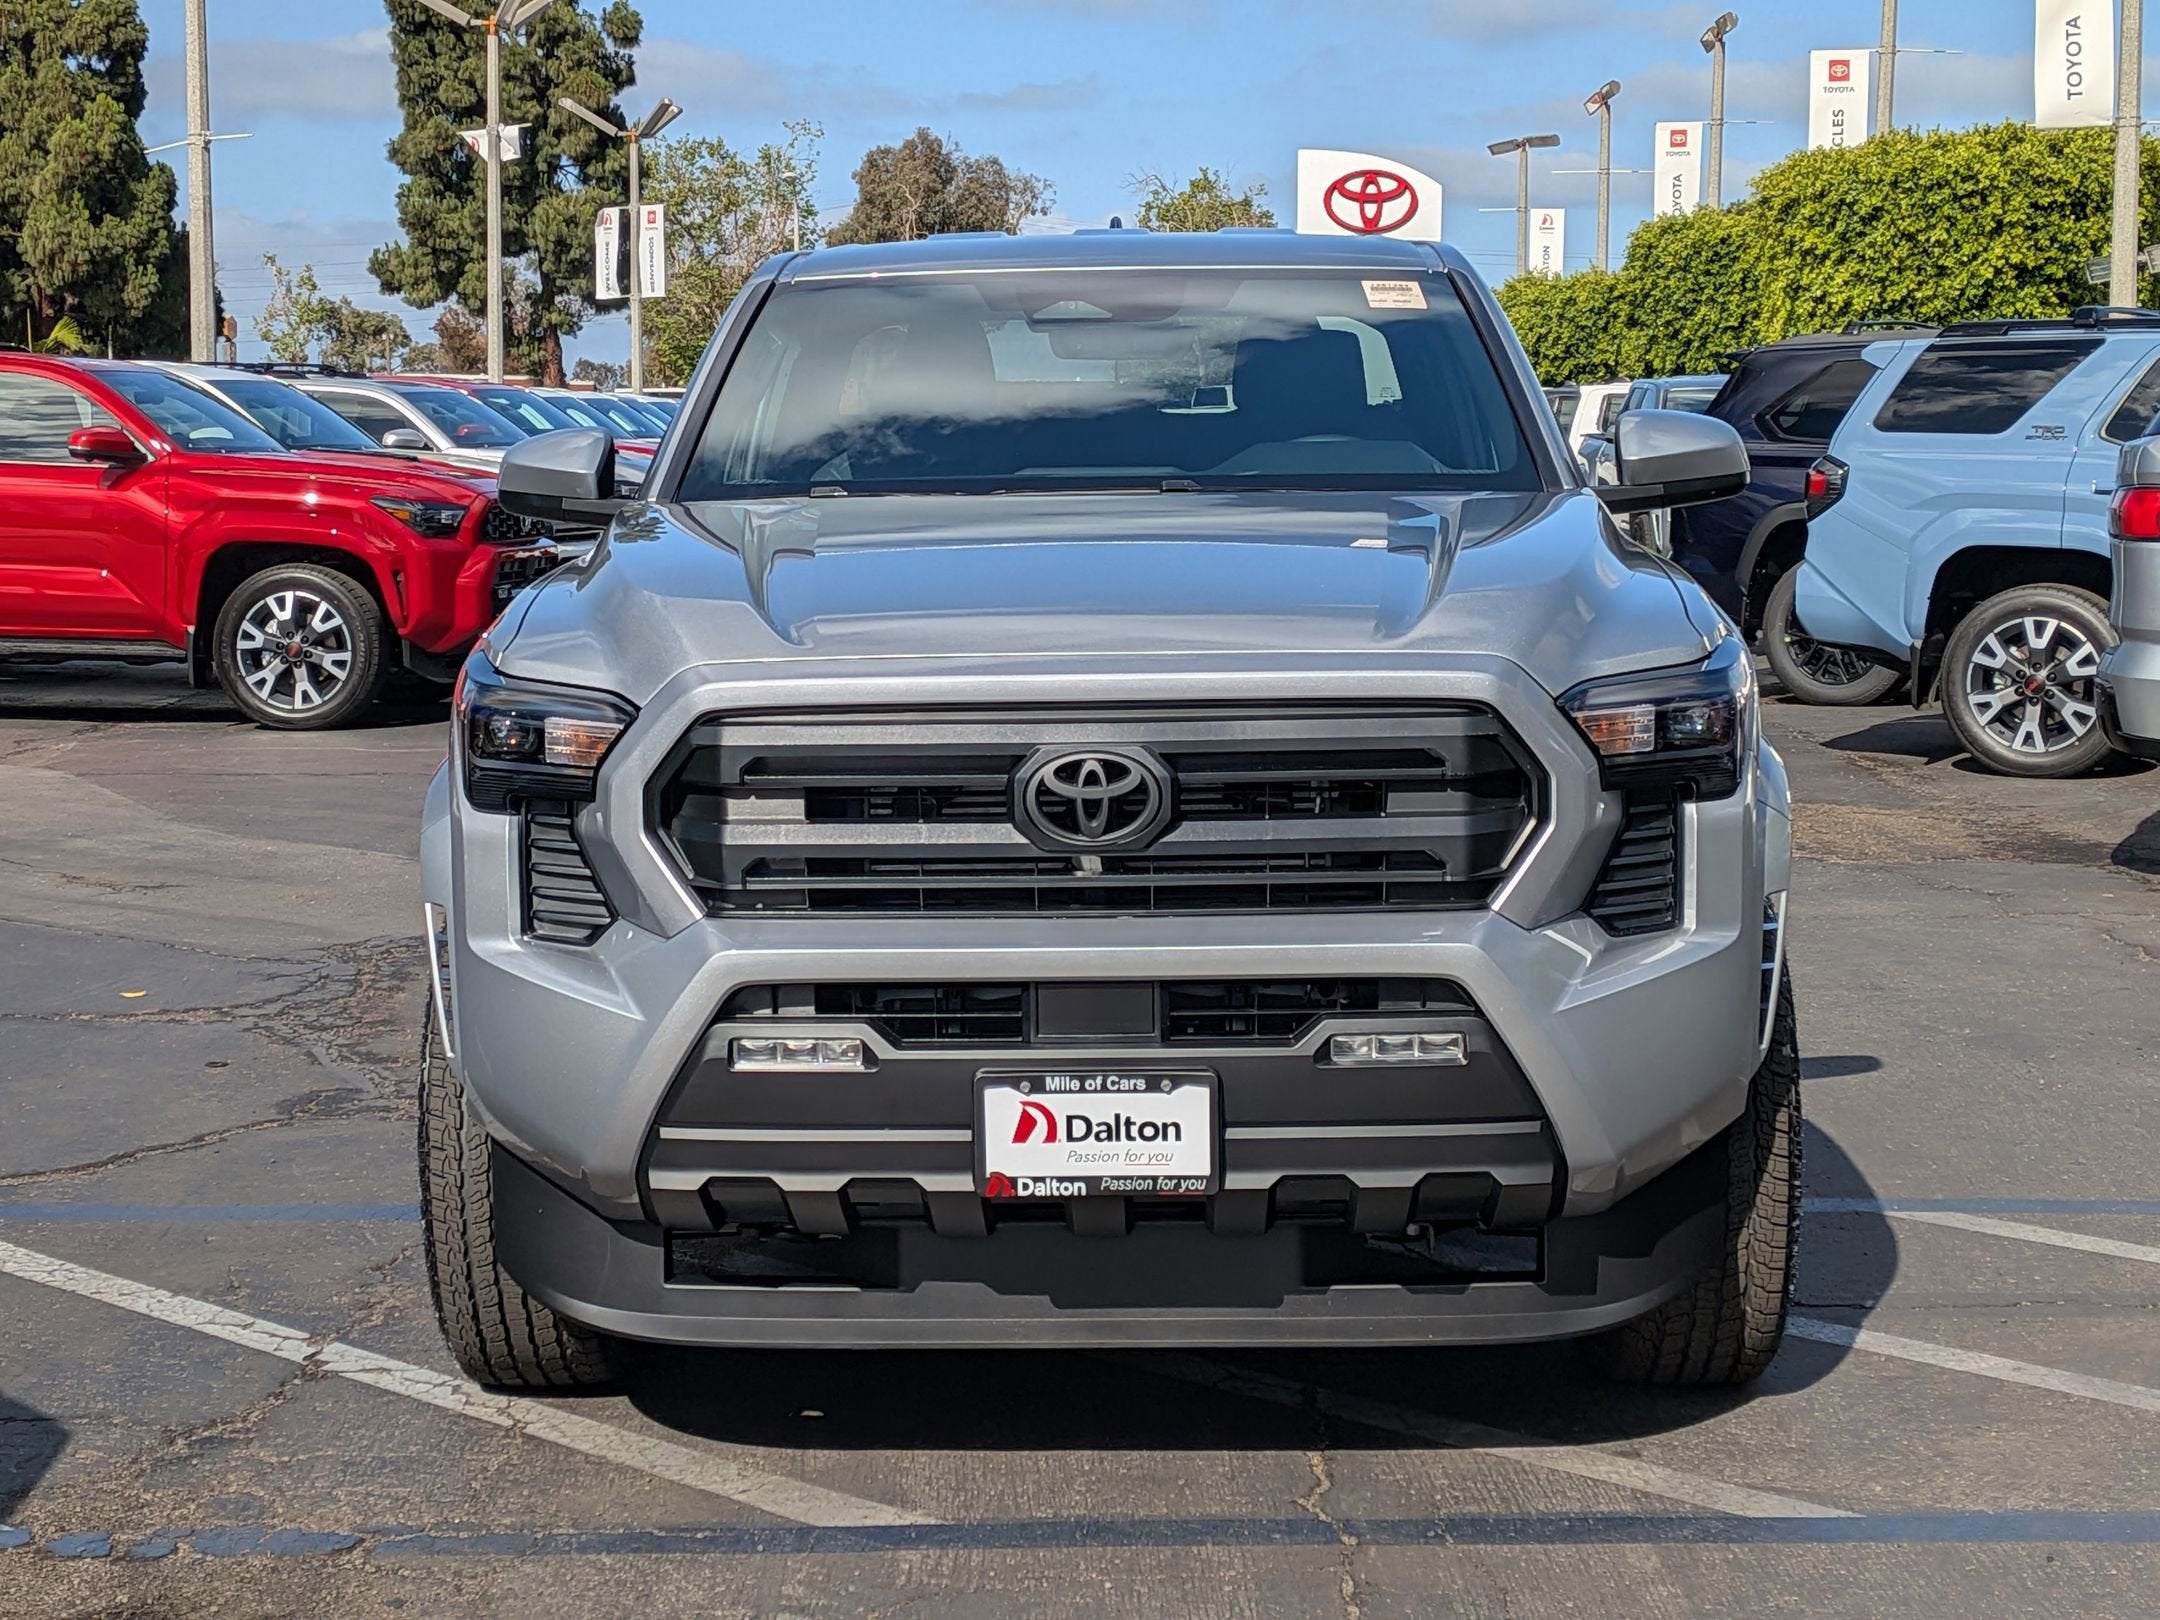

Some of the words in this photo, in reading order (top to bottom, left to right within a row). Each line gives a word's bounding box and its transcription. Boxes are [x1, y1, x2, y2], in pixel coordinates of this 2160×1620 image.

[2065, 15, 2083, 101] TOYOTA
[1823, 86, 1855, 94] TOYOTA
[1832, 109, 1844, 148] CLES
[1672, 173, 1682, 217] OYOTA
[1045, 1076, 1082, 1092] Mile
[1084, 1075, 1104, 1092] of
[1106, 1075, 1147, 1091] Cars
[1065, 1113, 1182, 1143] Dalton
[1066, 1150, 1120, 1164] Passion
[1123, 1149, 1145, 1164] for
[1147, 1152, 1174, 1166] you
[1017, 1177, 1087, 1197] Dalton
[1100, 1177, 1153, 1191] Passion
[1156, 1177, 1178, 1192] for
[1178, 1178, 1207, 1194] you
